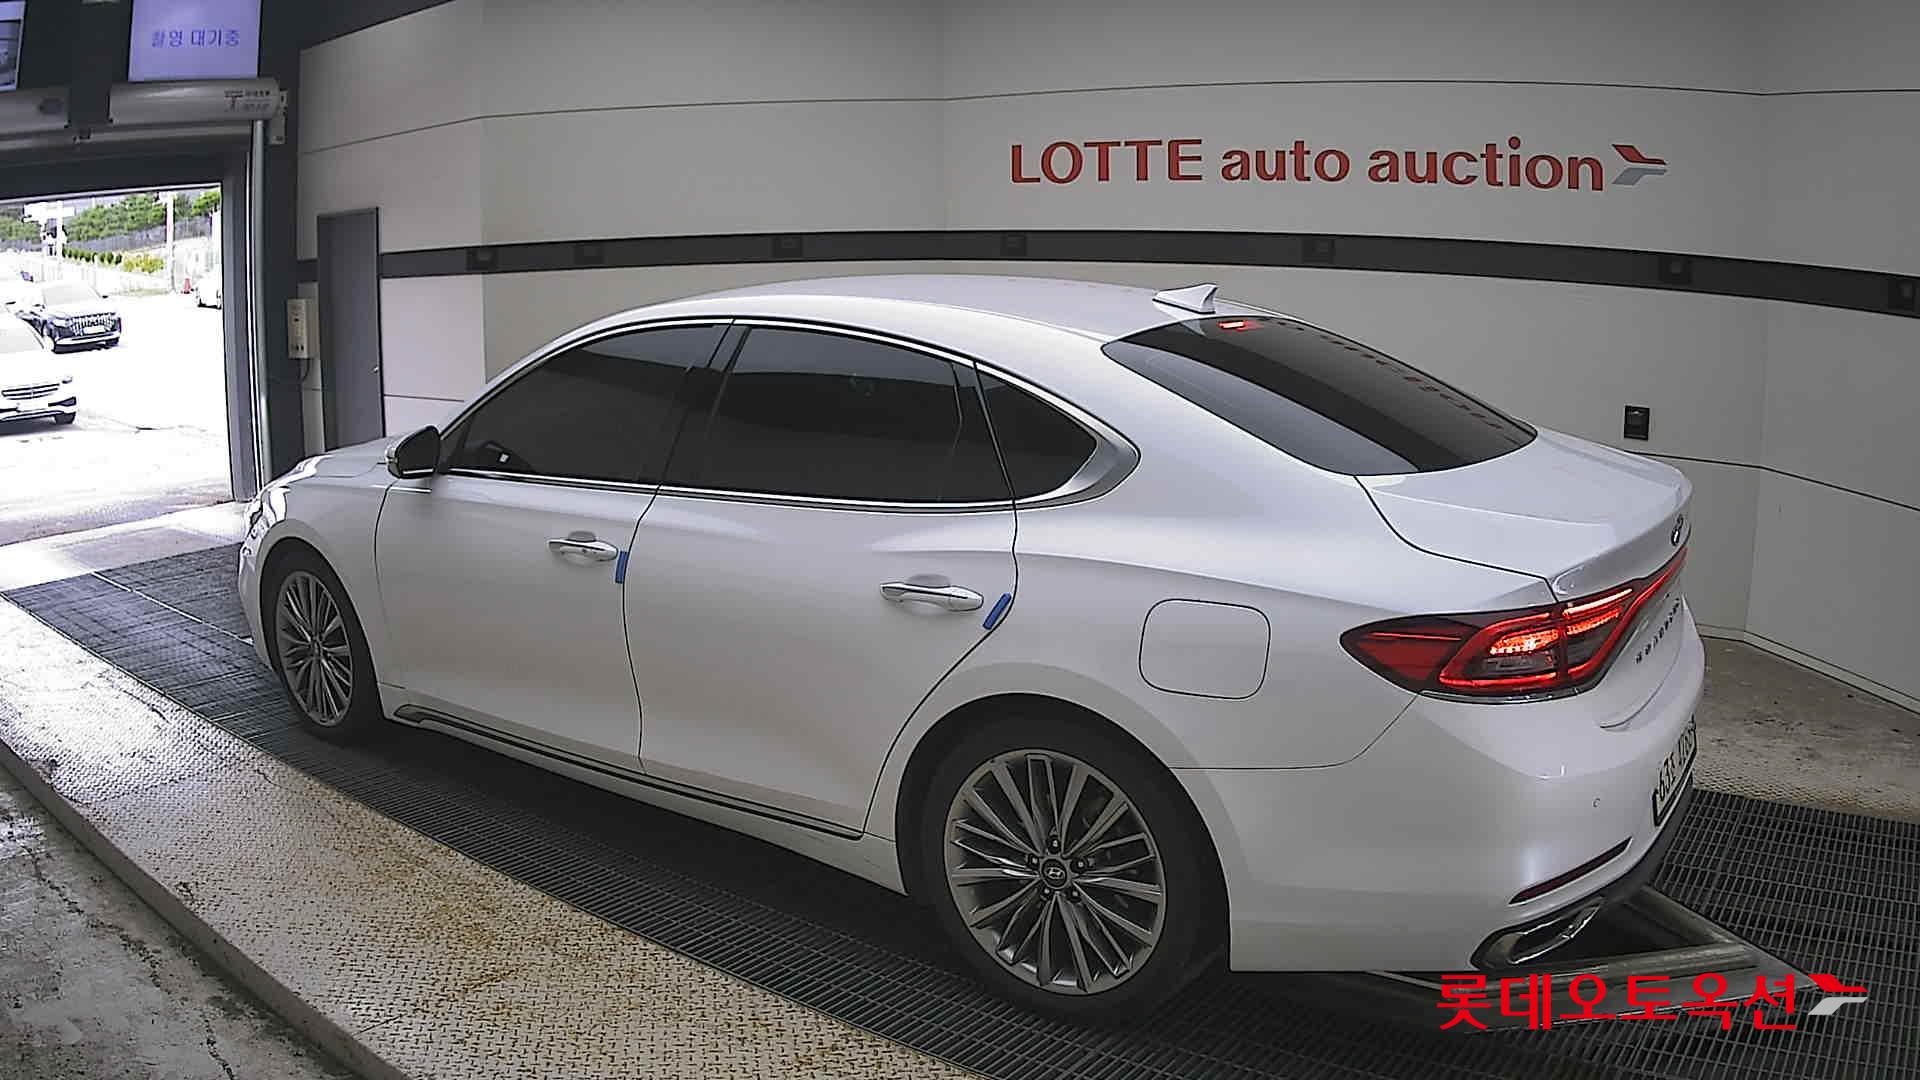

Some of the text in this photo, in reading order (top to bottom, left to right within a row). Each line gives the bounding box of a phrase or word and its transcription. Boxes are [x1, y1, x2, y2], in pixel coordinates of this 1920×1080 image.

[190, 28, 240, 48] 대기중
[1011, 136, 1604, 191] LOTTE auto auction
